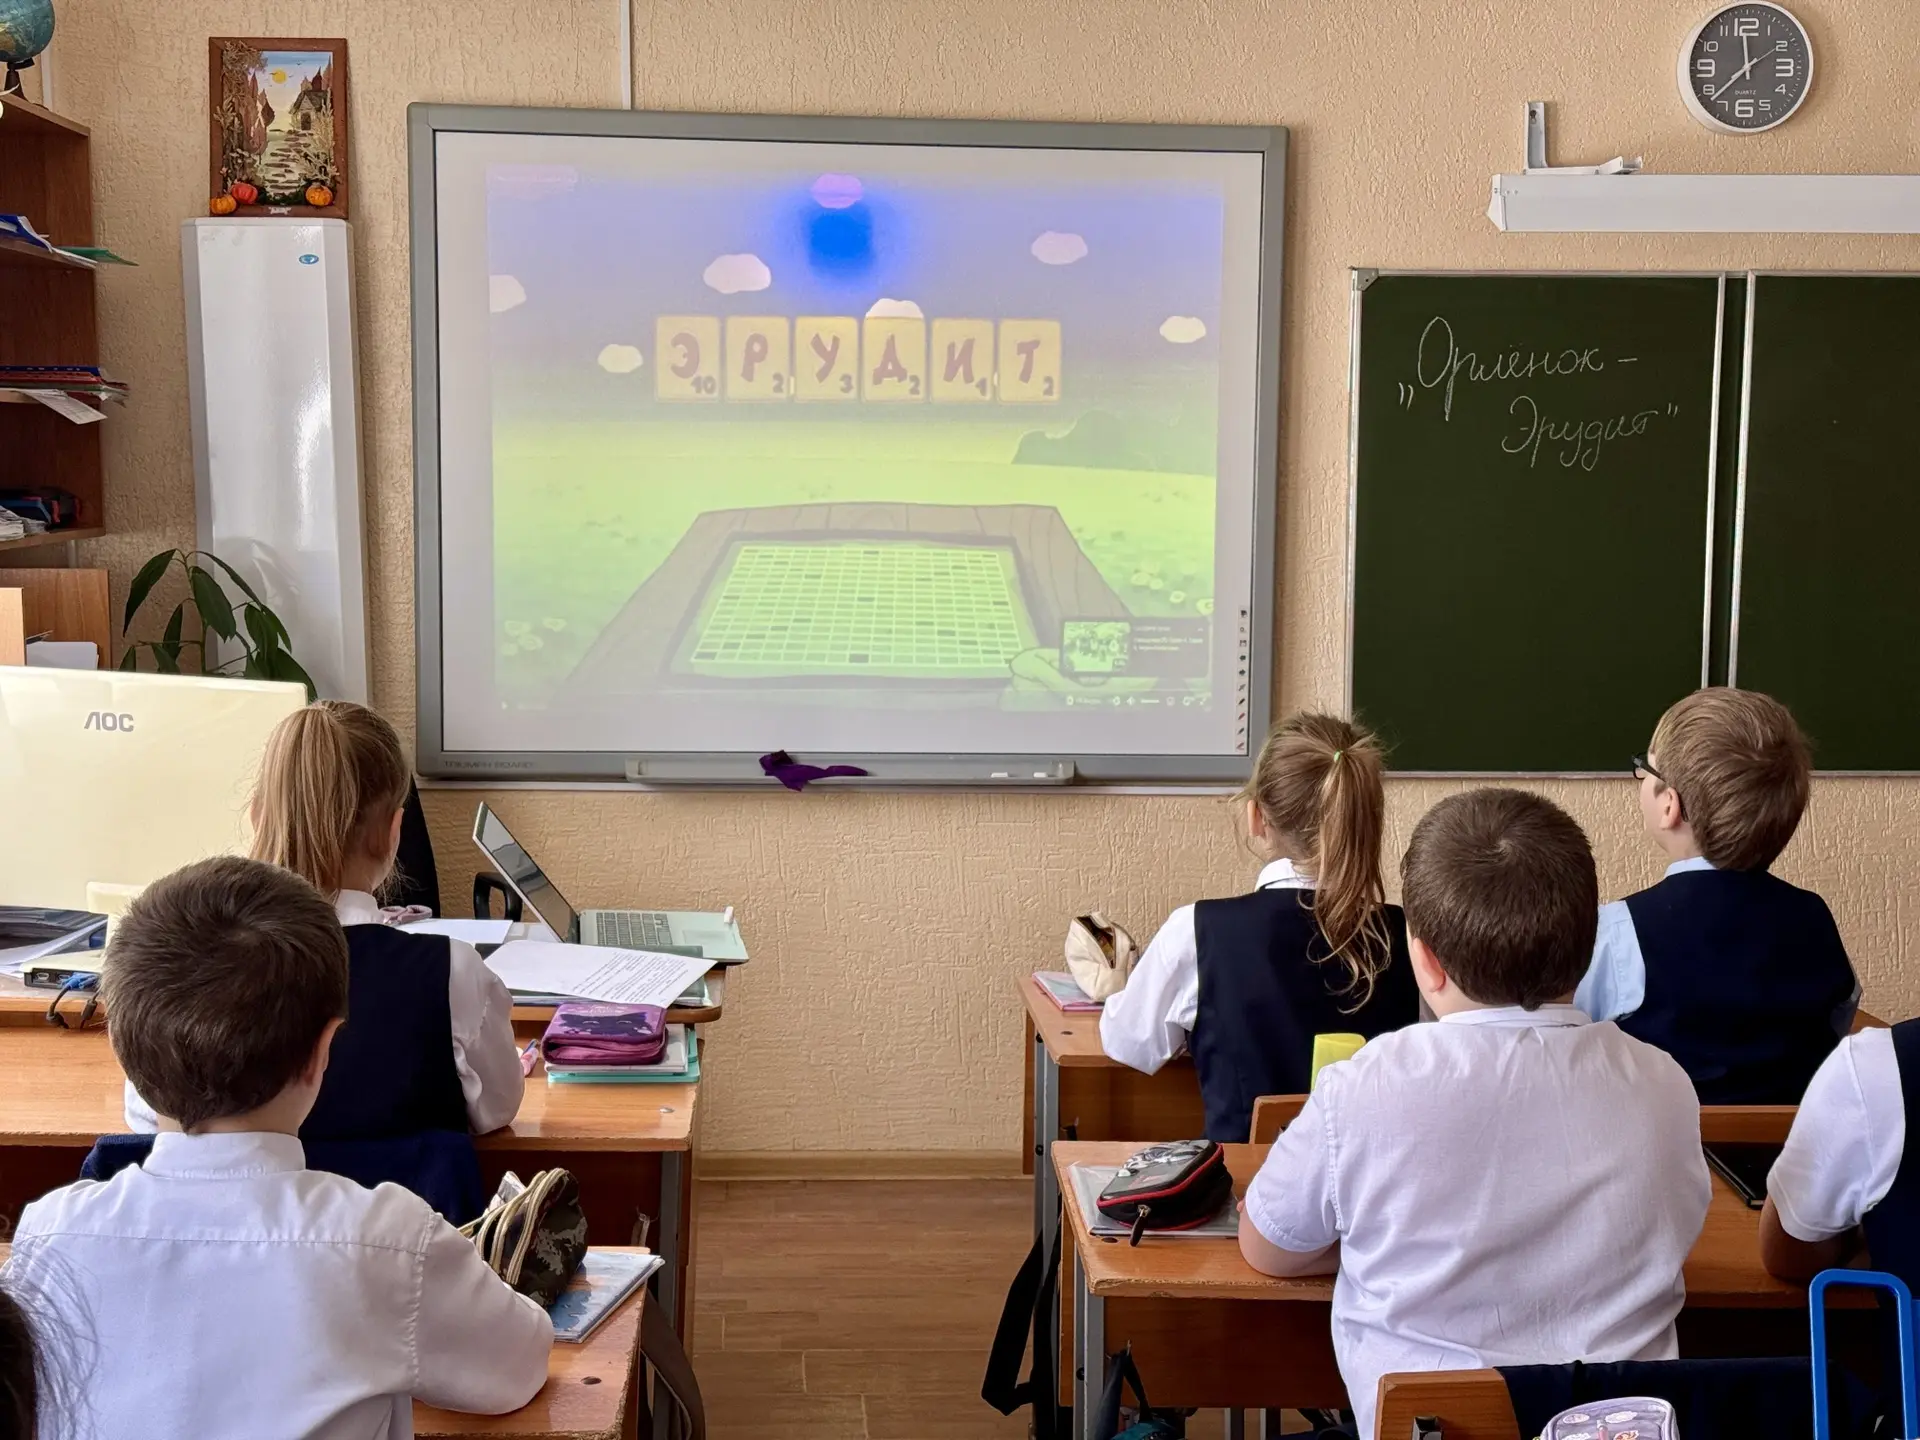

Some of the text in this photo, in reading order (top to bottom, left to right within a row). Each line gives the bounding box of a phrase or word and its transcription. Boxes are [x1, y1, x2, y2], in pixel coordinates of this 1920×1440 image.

[1720, 25, 1728, 36] 11
[1734, 18, 1759, 36] 12
[1767, 25, 1771, 36] 1
[1703, 41, 1719, 52] 10
[1775, 40, 1788, 52] 2
[1696, 59, 1716, 78] 9
[1775, 58, 1794, 77] 3
[1703, 84, 1715, 95] 8
[1774, 84, 1787, 95] 4
[1717, 100, 1729, 112] 7
[1735, 99, 1754, 118] 6
[1758, 100, 1771, 111] 5
[670, 332, 1041, 386] ЭРУДИТ
[690, 374, 1055, 397] 10 2 3 2 1 2
[84, 711, 134, 732] AOC
